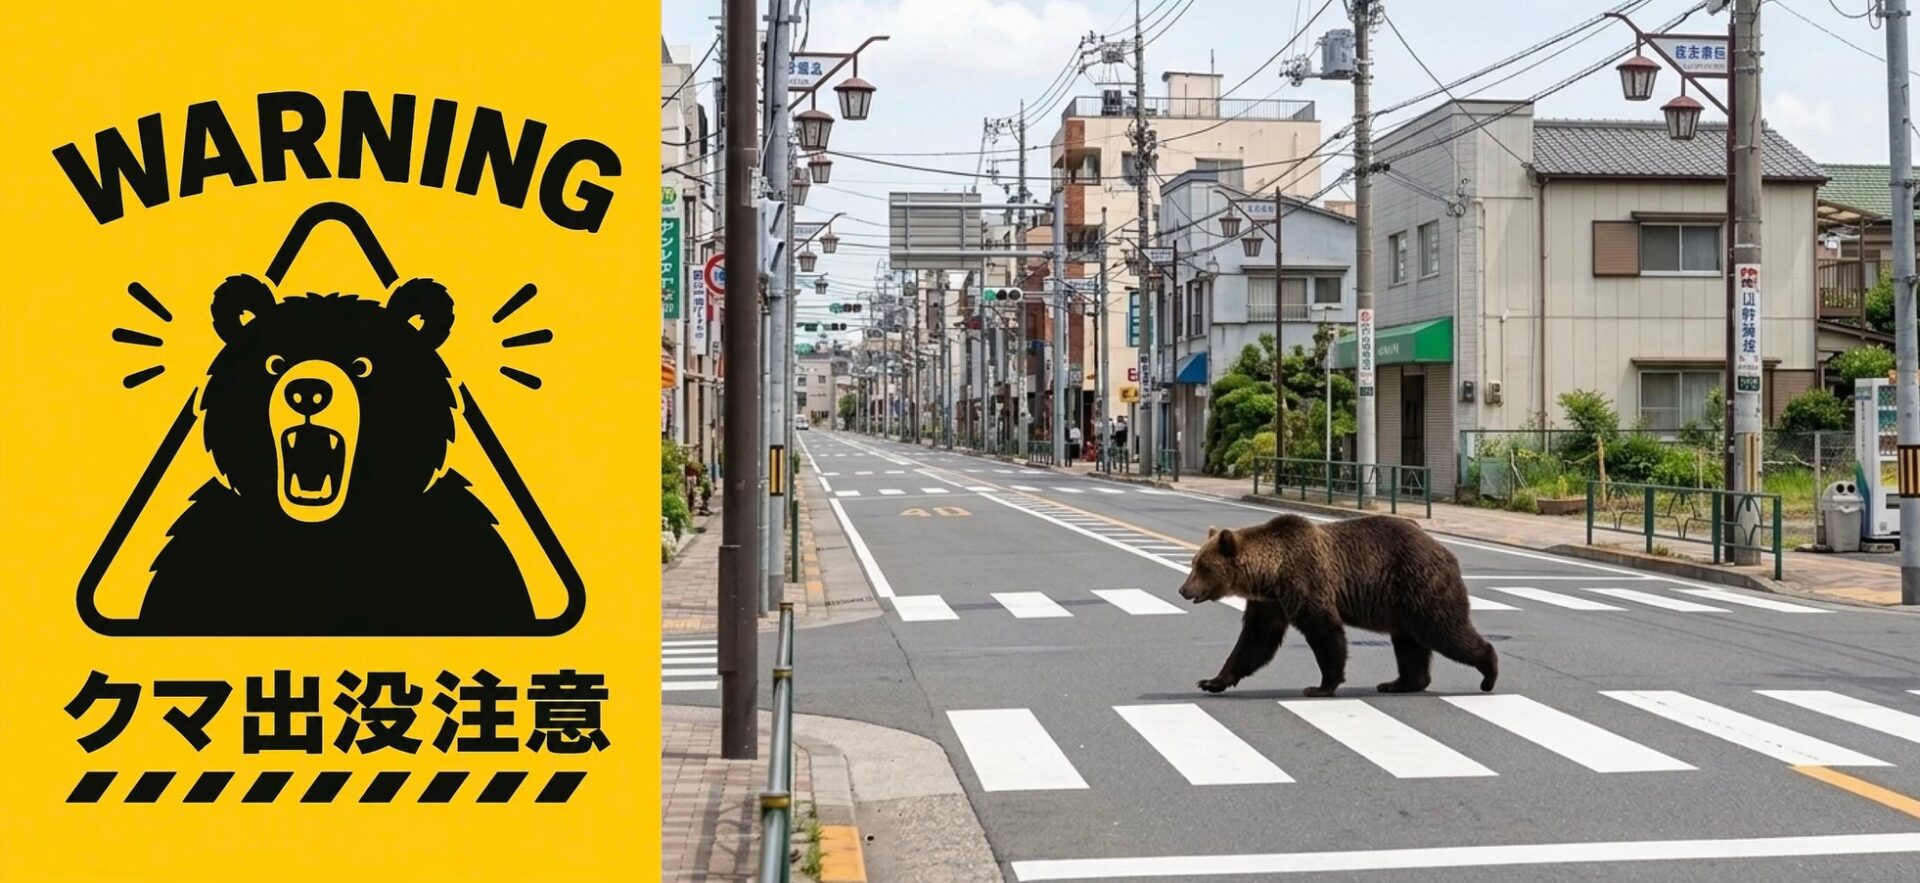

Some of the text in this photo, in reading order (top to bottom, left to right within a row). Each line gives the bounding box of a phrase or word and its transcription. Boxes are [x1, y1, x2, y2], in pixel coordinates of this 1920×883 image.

[52, 91, 621, 233] WARNING
[64, 669, 610, 754] クマ出没注意
